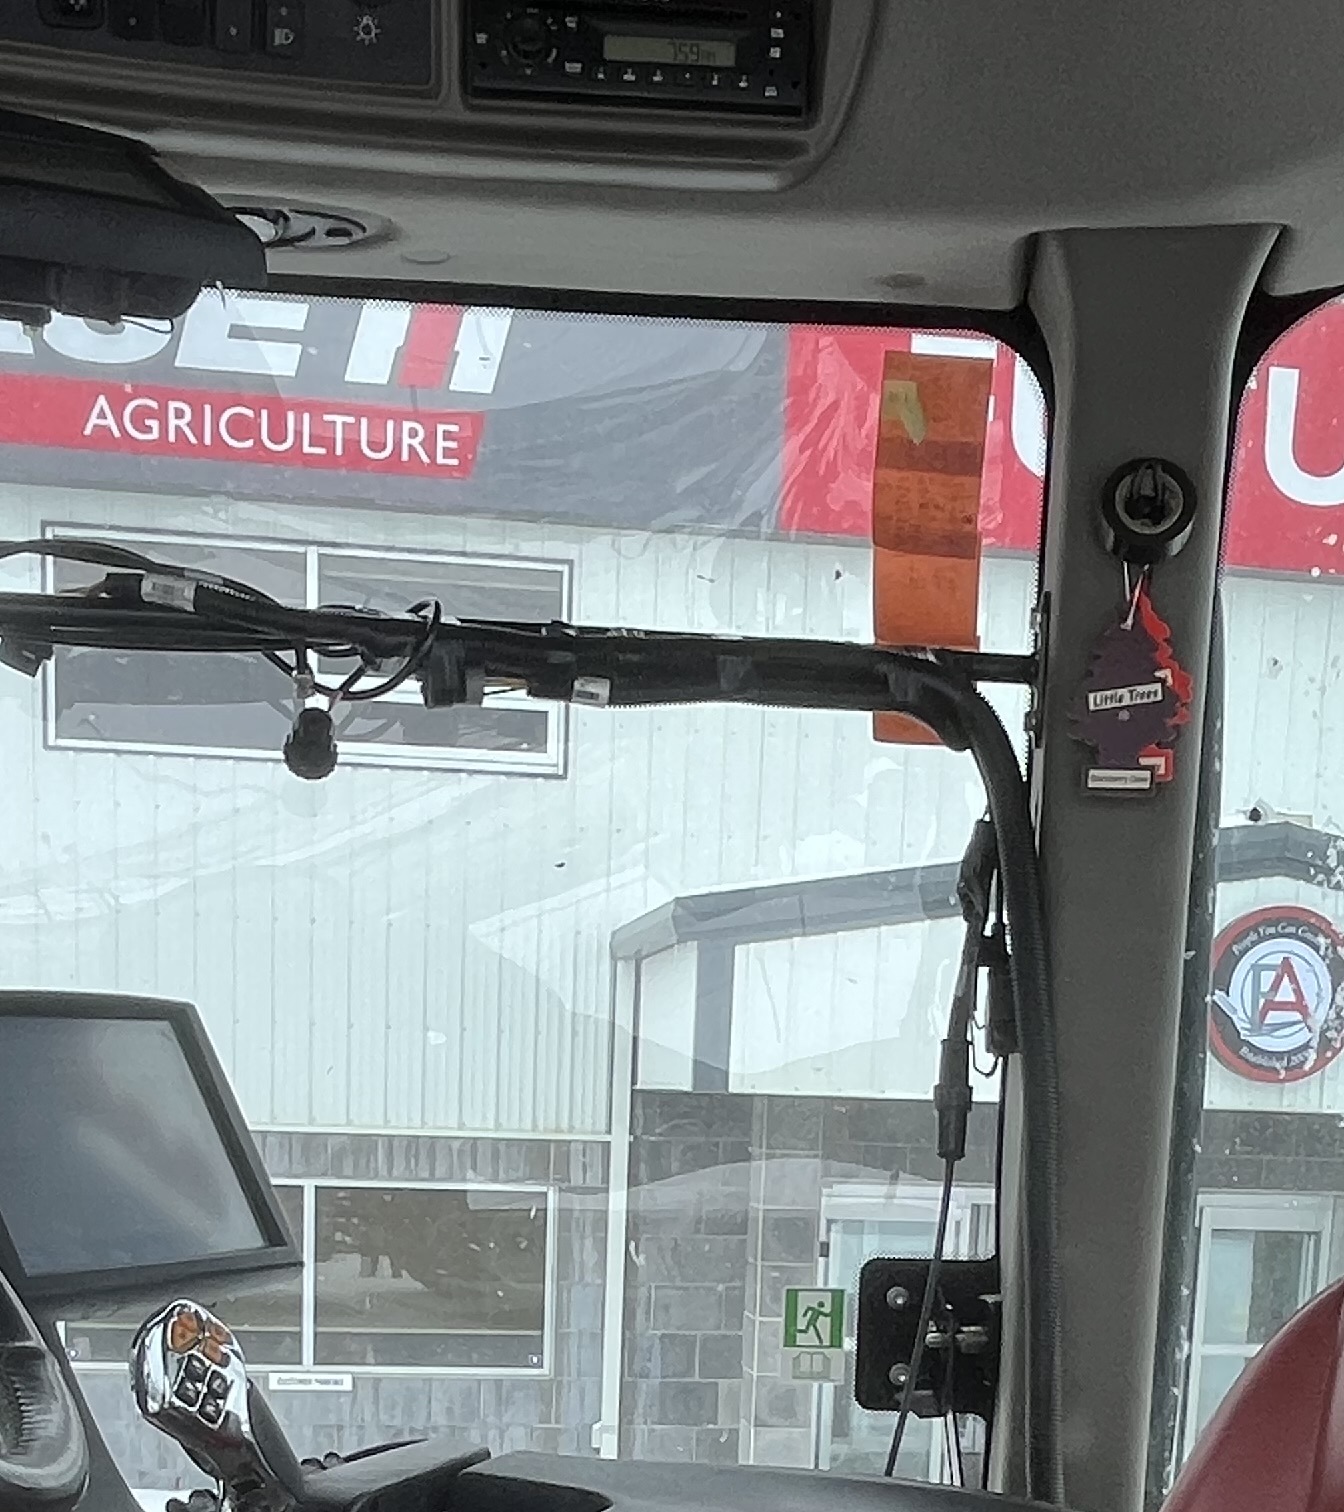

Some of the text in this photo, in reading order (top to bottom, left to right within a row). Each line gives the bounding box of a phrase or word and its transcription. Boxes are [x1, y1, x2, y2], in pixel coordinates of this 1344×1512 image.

[82, 394, 461, 467] AGRICULTURE
[1093, 687, 1158, 706] Little Trees
